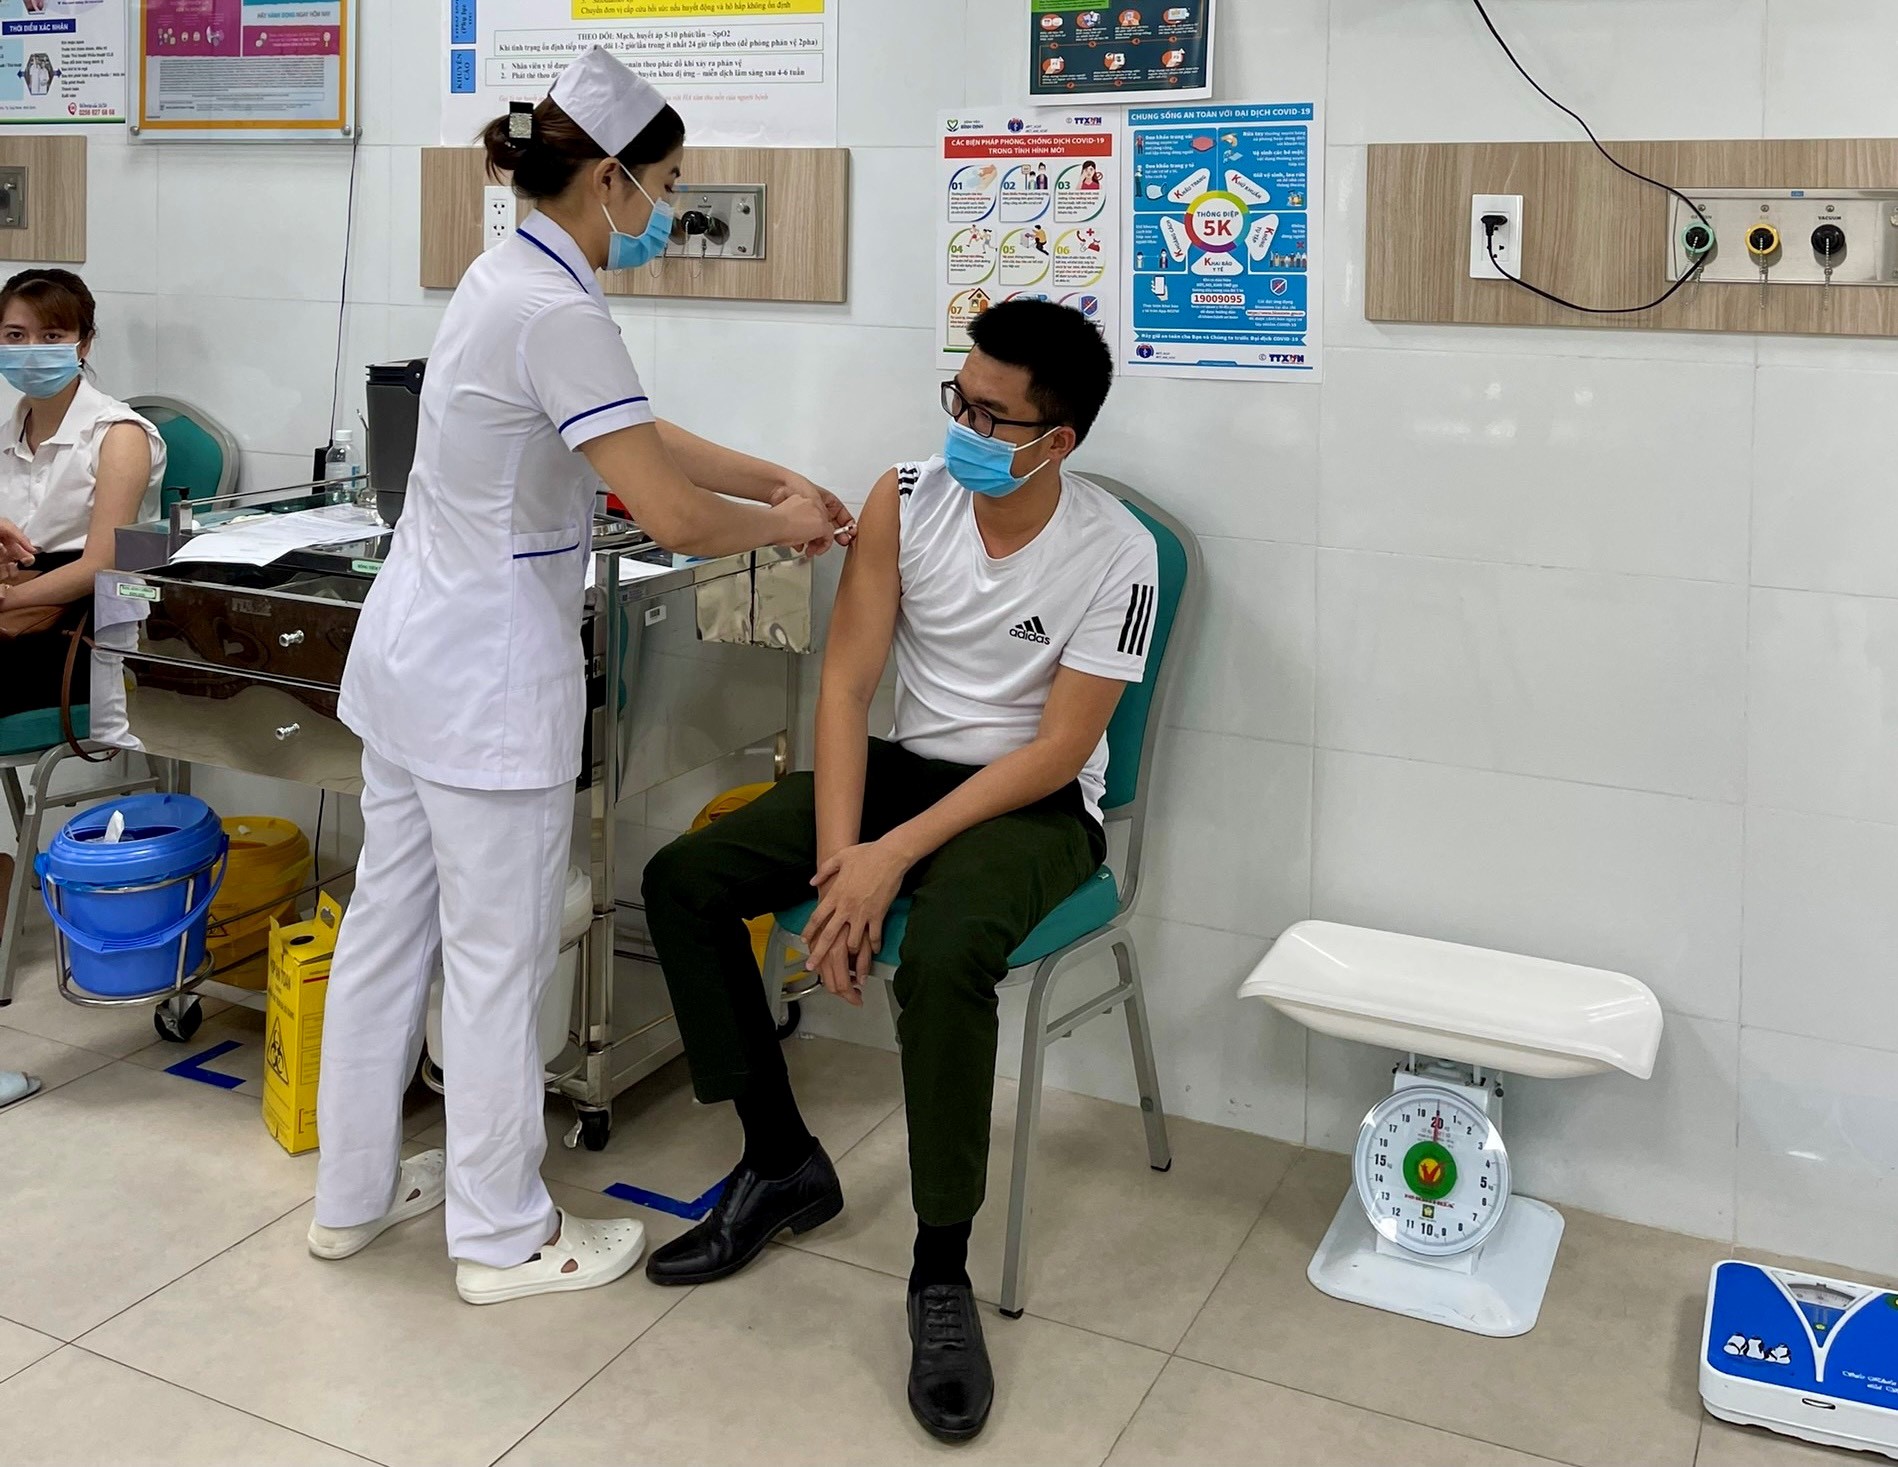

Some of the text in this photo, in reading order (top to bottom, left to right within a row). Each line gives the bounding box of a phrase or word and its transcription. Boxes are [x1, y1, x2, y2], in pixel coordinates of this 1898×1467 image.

[577, 33, 598, 41] THEO
[712, 30, 731, 39] SpO2
[636, 70, 657, 78] huyên
[1131, 107, 1311, 121] CHUNG SỐNG AN TOÀN VỚI ĐẠI DỊCH COVID-19
[951, 138, 964, 146] CÁC
[966, 138, 980, 147] BIỆN
[1053, 138, 1071, 146] DỊCH
[951, 182, 963, 190] 01
[1003, 182, 1015, 190] 02
[1058, 181, 1071, 190] 03
[1196, 210, 1240, 218] THÔNG ĐIỆP
[1203, 219, 1233, 236] 5K
[951, 244, 963, 254] 04
[1003, 245, 1015, 254] 05
[1056, 246, 1070, 255] 06
[1193, 294, 1243, 303] 19009095
[950, 306, 963, 315] 07
[1008, 627, 1051, 646] adidas
[1417, 1108, 1426, 1117] 19
[1402, 1114, 1410, 1123] 18
[1430, 1116, 1444, 1130] 20
[1453, 1115, 1457, 1124] 1
[1389, 1124, 1398, 1133] 17
[1466, 1126, 1472, 1135] 2
[1379, 1138, 1388, 1147] 16
[1478, 1142, 1483, 1151] 3
[1374, 1153, 1387, 1167] 15
[1486, 1160, 1491, 1169] 4
[1375, 1173, 1384, 1183] 14
[1480, 1176, 1487, 1189] 5
[1381, 1191, 1390, 1201] 13
[1392, 1207, 1401, 1217] 12
[1472, 1212, 1478, 1221] 7
[1406, 1219, 1414, 1229] 11
[1458, 1222, 1463, 1232] 8
[1421, 1222, 1433, 1236] 10
